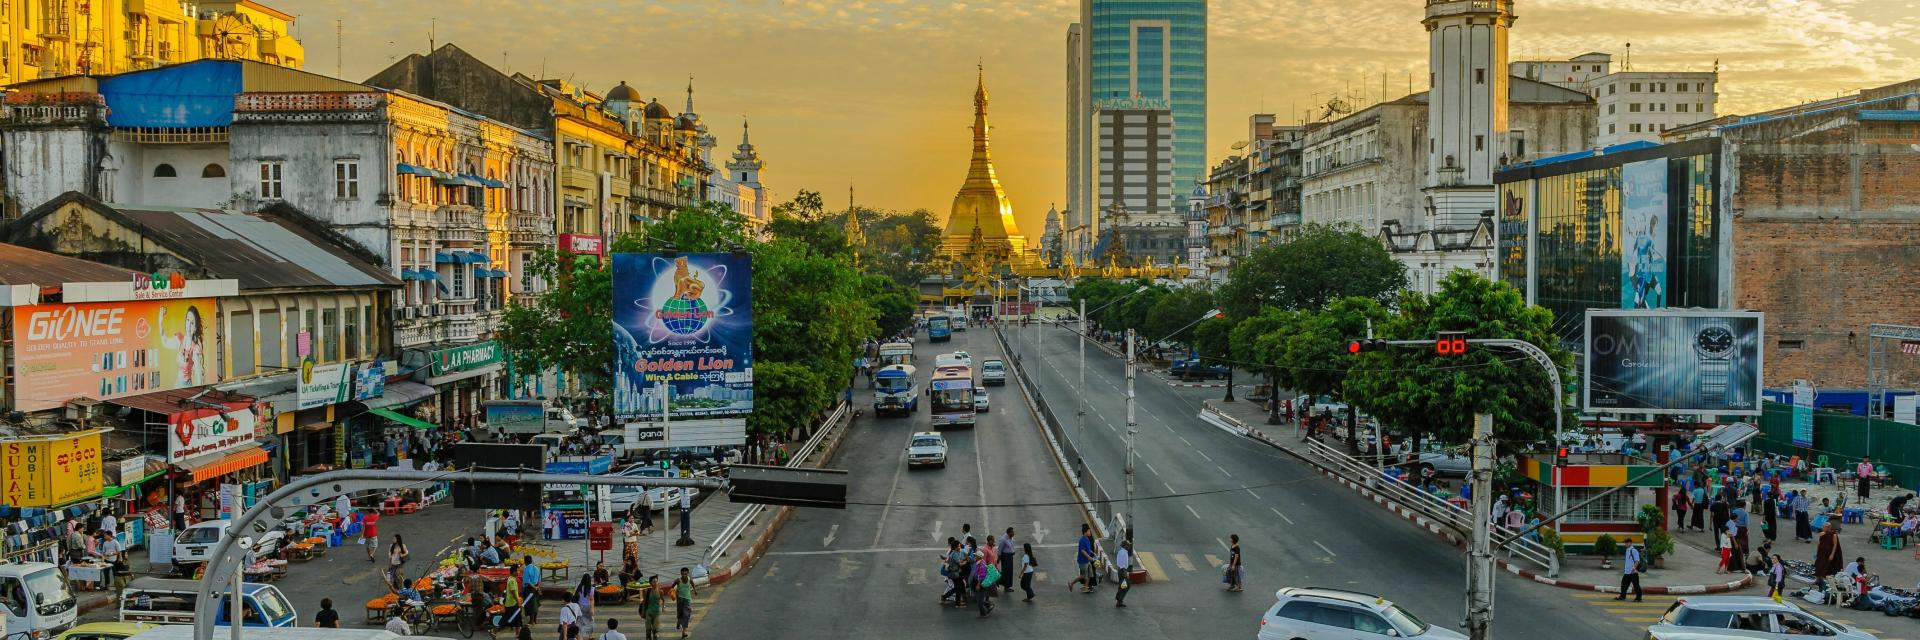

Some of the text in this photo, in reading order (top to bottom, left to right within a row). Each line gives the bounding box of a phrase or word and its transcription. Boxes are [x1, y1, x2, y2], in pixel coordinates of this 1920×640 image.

[1137, 98, 1169, 109] BANK
[151, 271, 166, 290] Co
[134, 291, 144, 299] Sale
[151, 290, 168, 298] Service
[655, 308, 714, 320] Golden Lion
[463, 344, 495, 365] PHARMACY
[635, 357, 734, 373] Golden Lion
[645, 372, 698, 382] Wire & Cable
[213, 420, 224, 435] Co
[8, 442, 21, 507] SULAY
[27, 445, 37, 500] MOBILE
